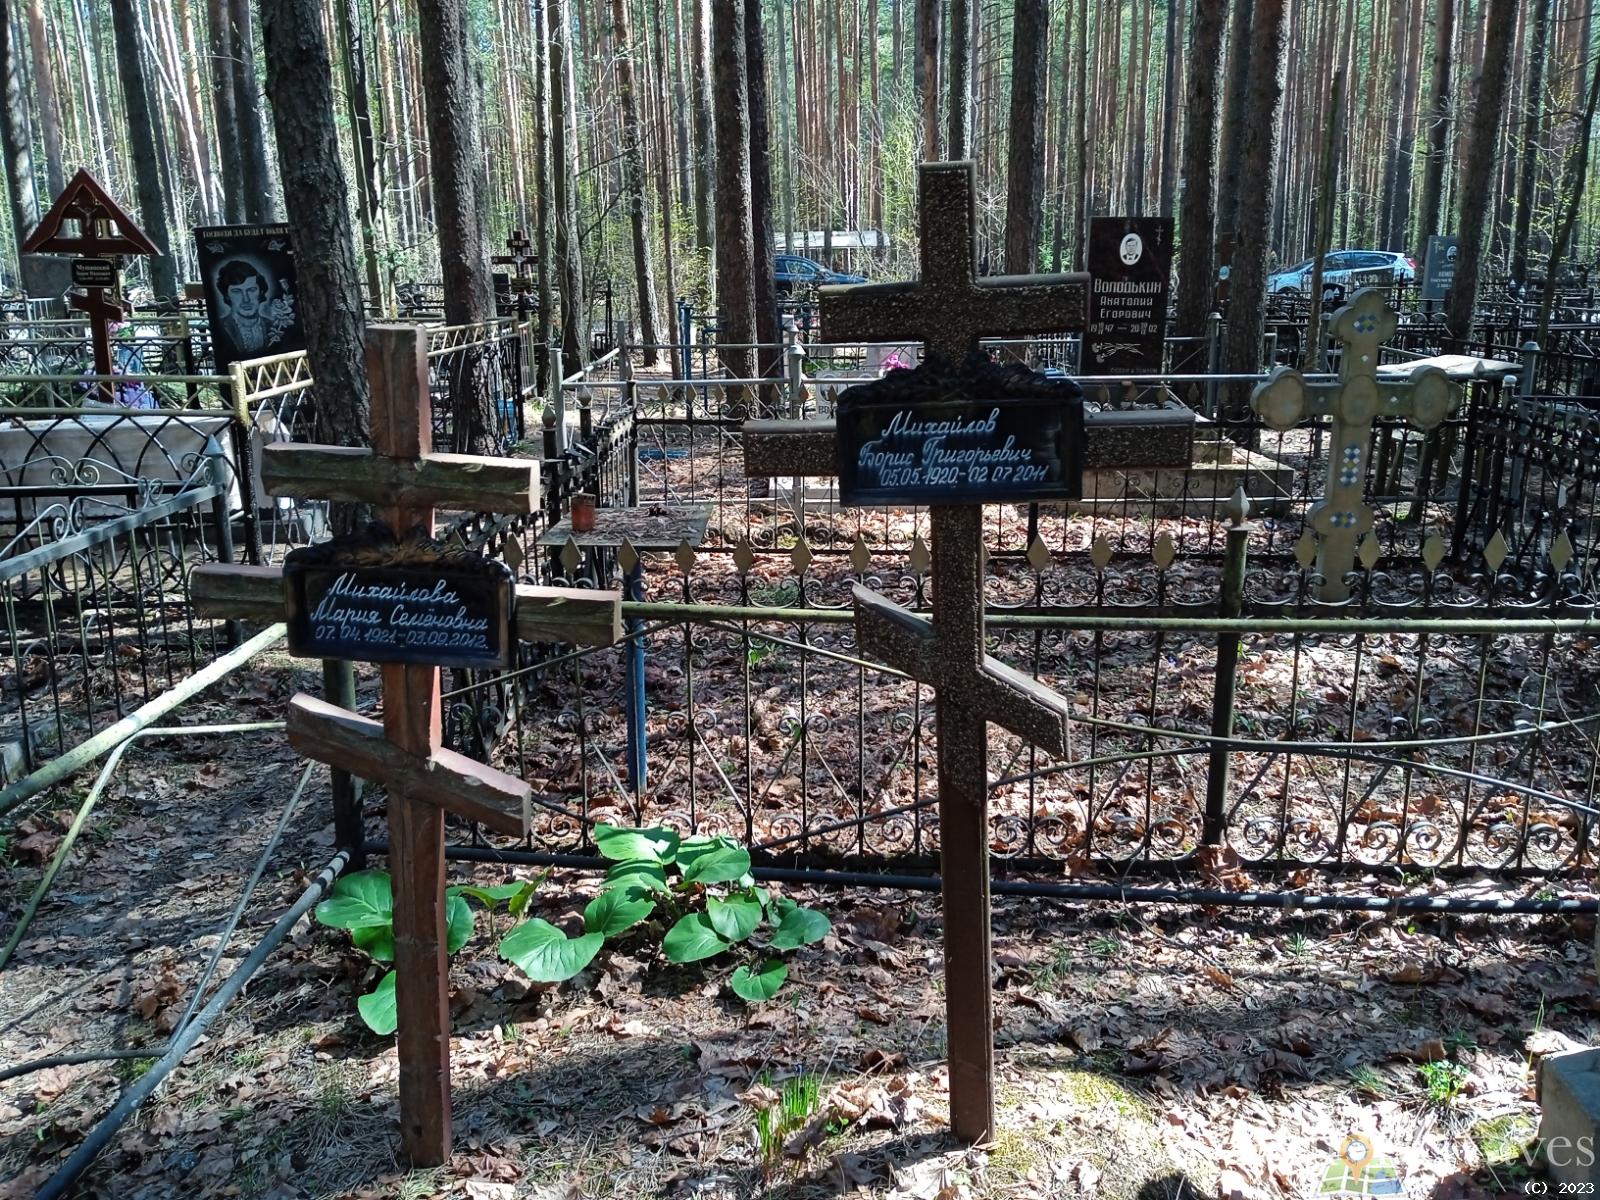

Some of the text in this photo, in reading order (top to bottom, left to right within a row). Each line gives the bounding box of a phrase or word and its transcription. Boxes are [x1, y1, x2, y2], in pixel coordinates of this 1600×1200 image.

[881, 408, 1000, 437] Михайлов
[858, 434, 1032, 475] Борис Григорьевич
[328, 572, 460, 604] Михайлова
[310, 597, 489, 630] Мария Семёновна
